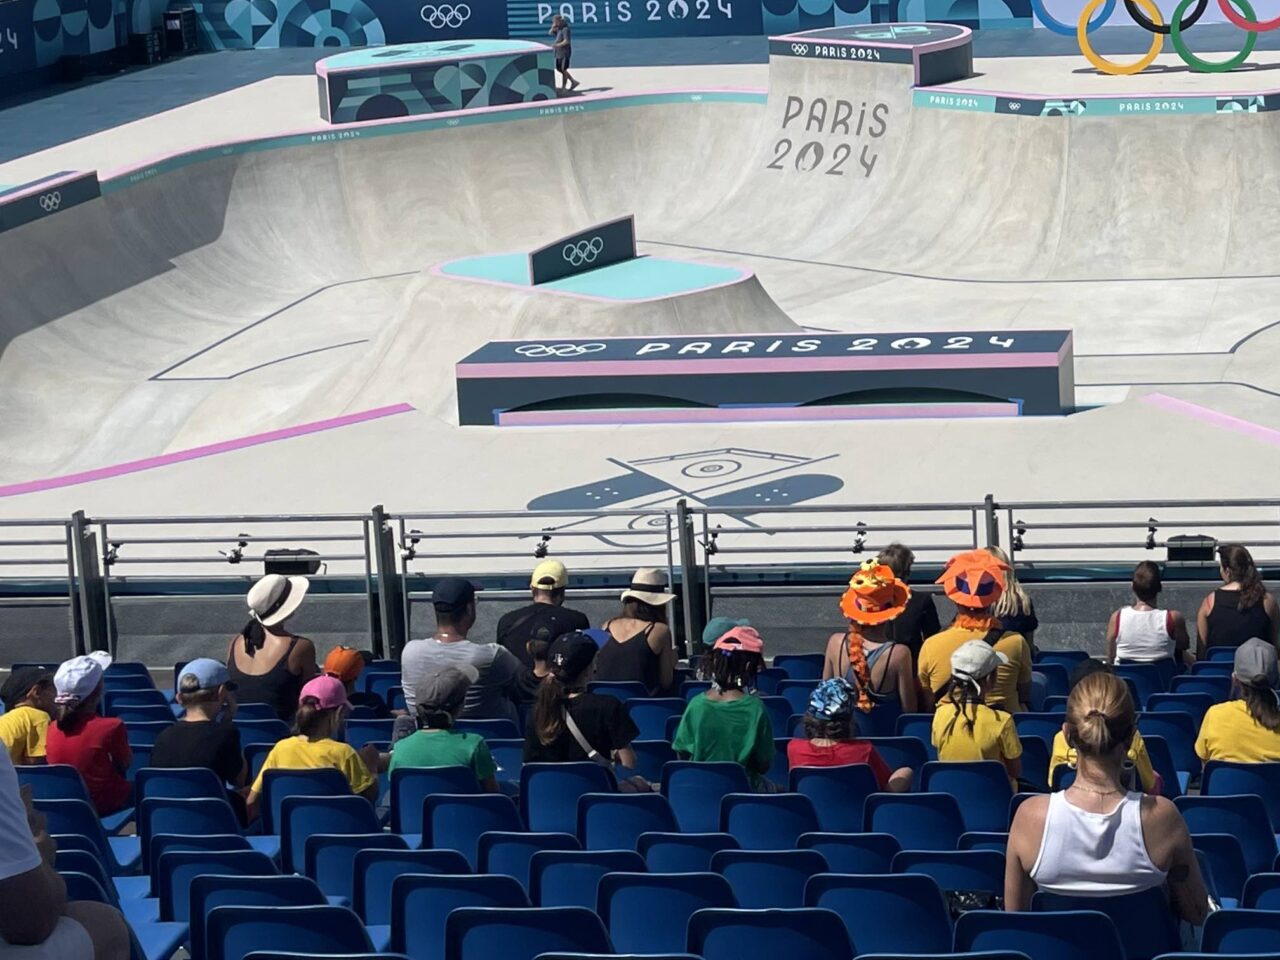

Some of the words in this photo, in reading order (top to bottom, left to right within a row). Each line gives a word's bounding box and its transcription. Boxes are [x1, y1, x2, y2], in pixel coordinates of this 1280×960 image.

[537, 0, 632, 25] PARiS
[815, 45, 847, 58] PARIS
[850, 47, 880, 60] 2024
[930, 95, 954, 106] PARIS
[955, 97, 978, 108] 2024
[1119, 102, 1151, 112] PARIS
[1154, 101, 1184, 111] 2024
[782, 95, 889, 138] PARiS
[766, 138, 878, 178] 2024
[635, 340, 822, 356] PARIS
[846, 336, 1015, 351] 2024
